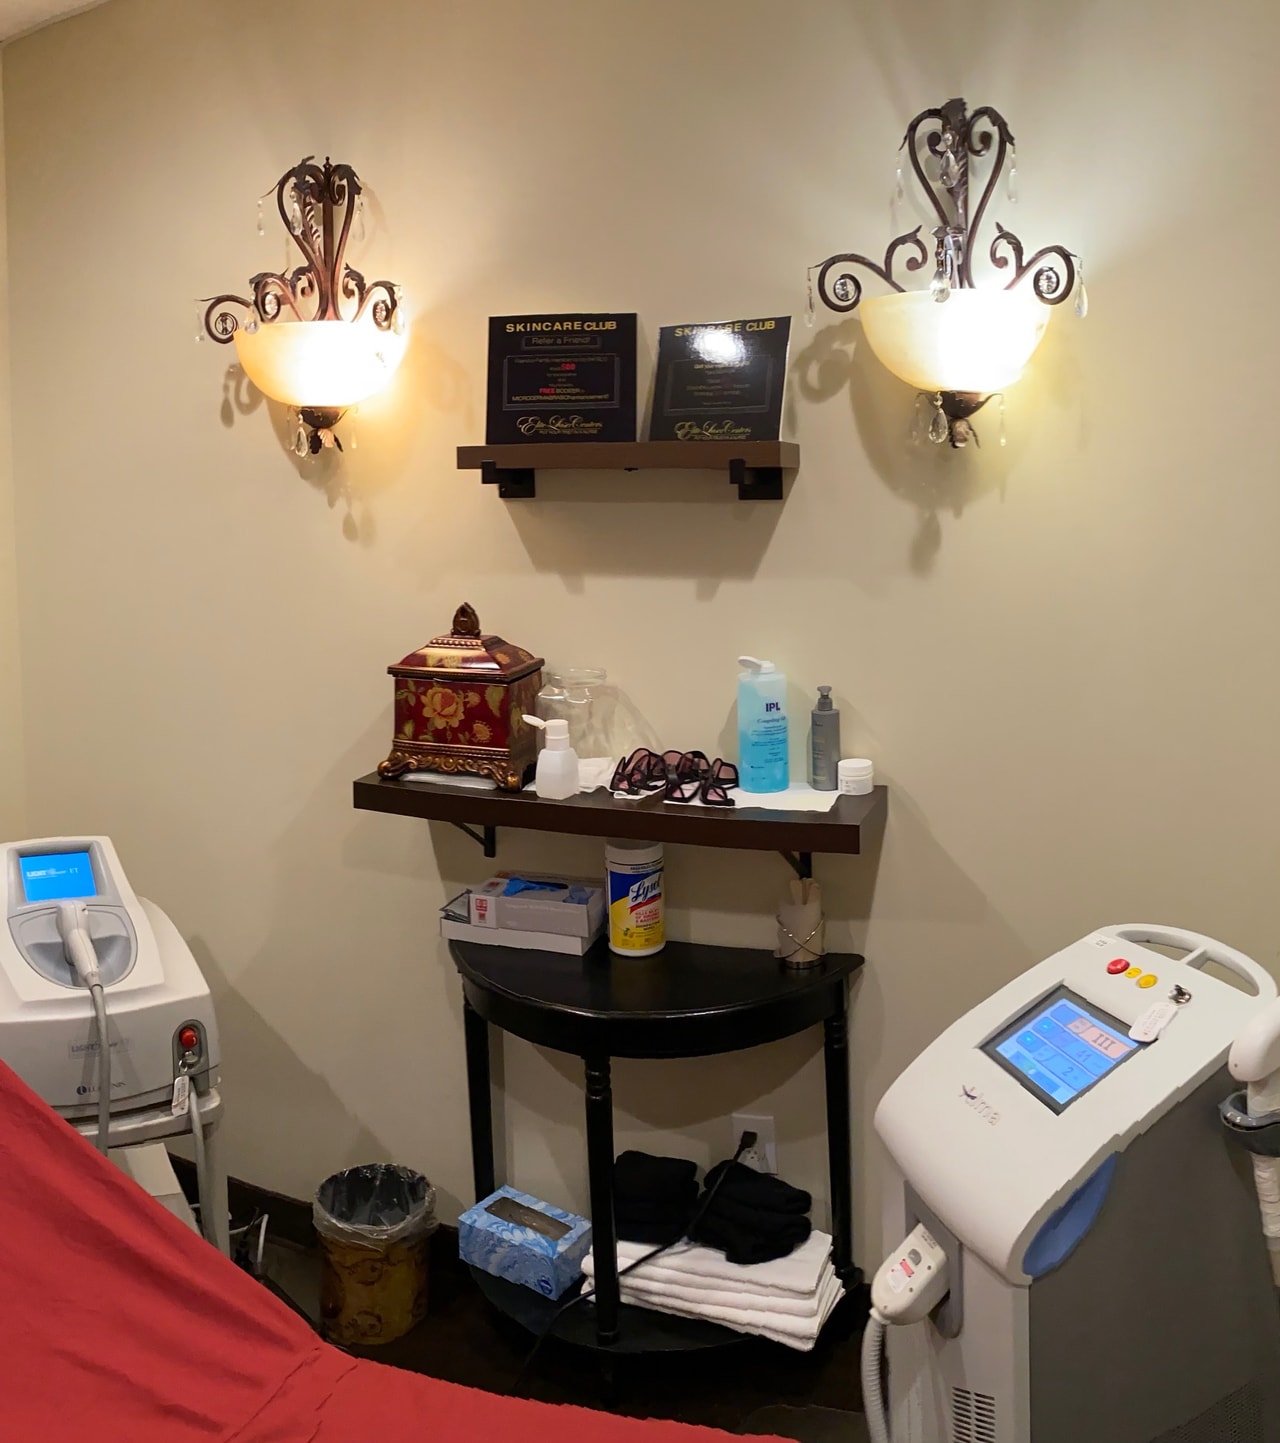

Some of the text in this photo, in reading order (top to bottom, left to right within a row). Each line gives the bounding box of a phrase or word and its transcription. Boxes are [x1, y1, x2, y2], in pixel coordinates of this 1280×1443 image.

[506, 321, 617, 333] SKINCARE CLUB
[746, 320, 776, 332] CLUB
[765, 702, 781, 713] IPL
[631, 873, 662, 903] Lysol
